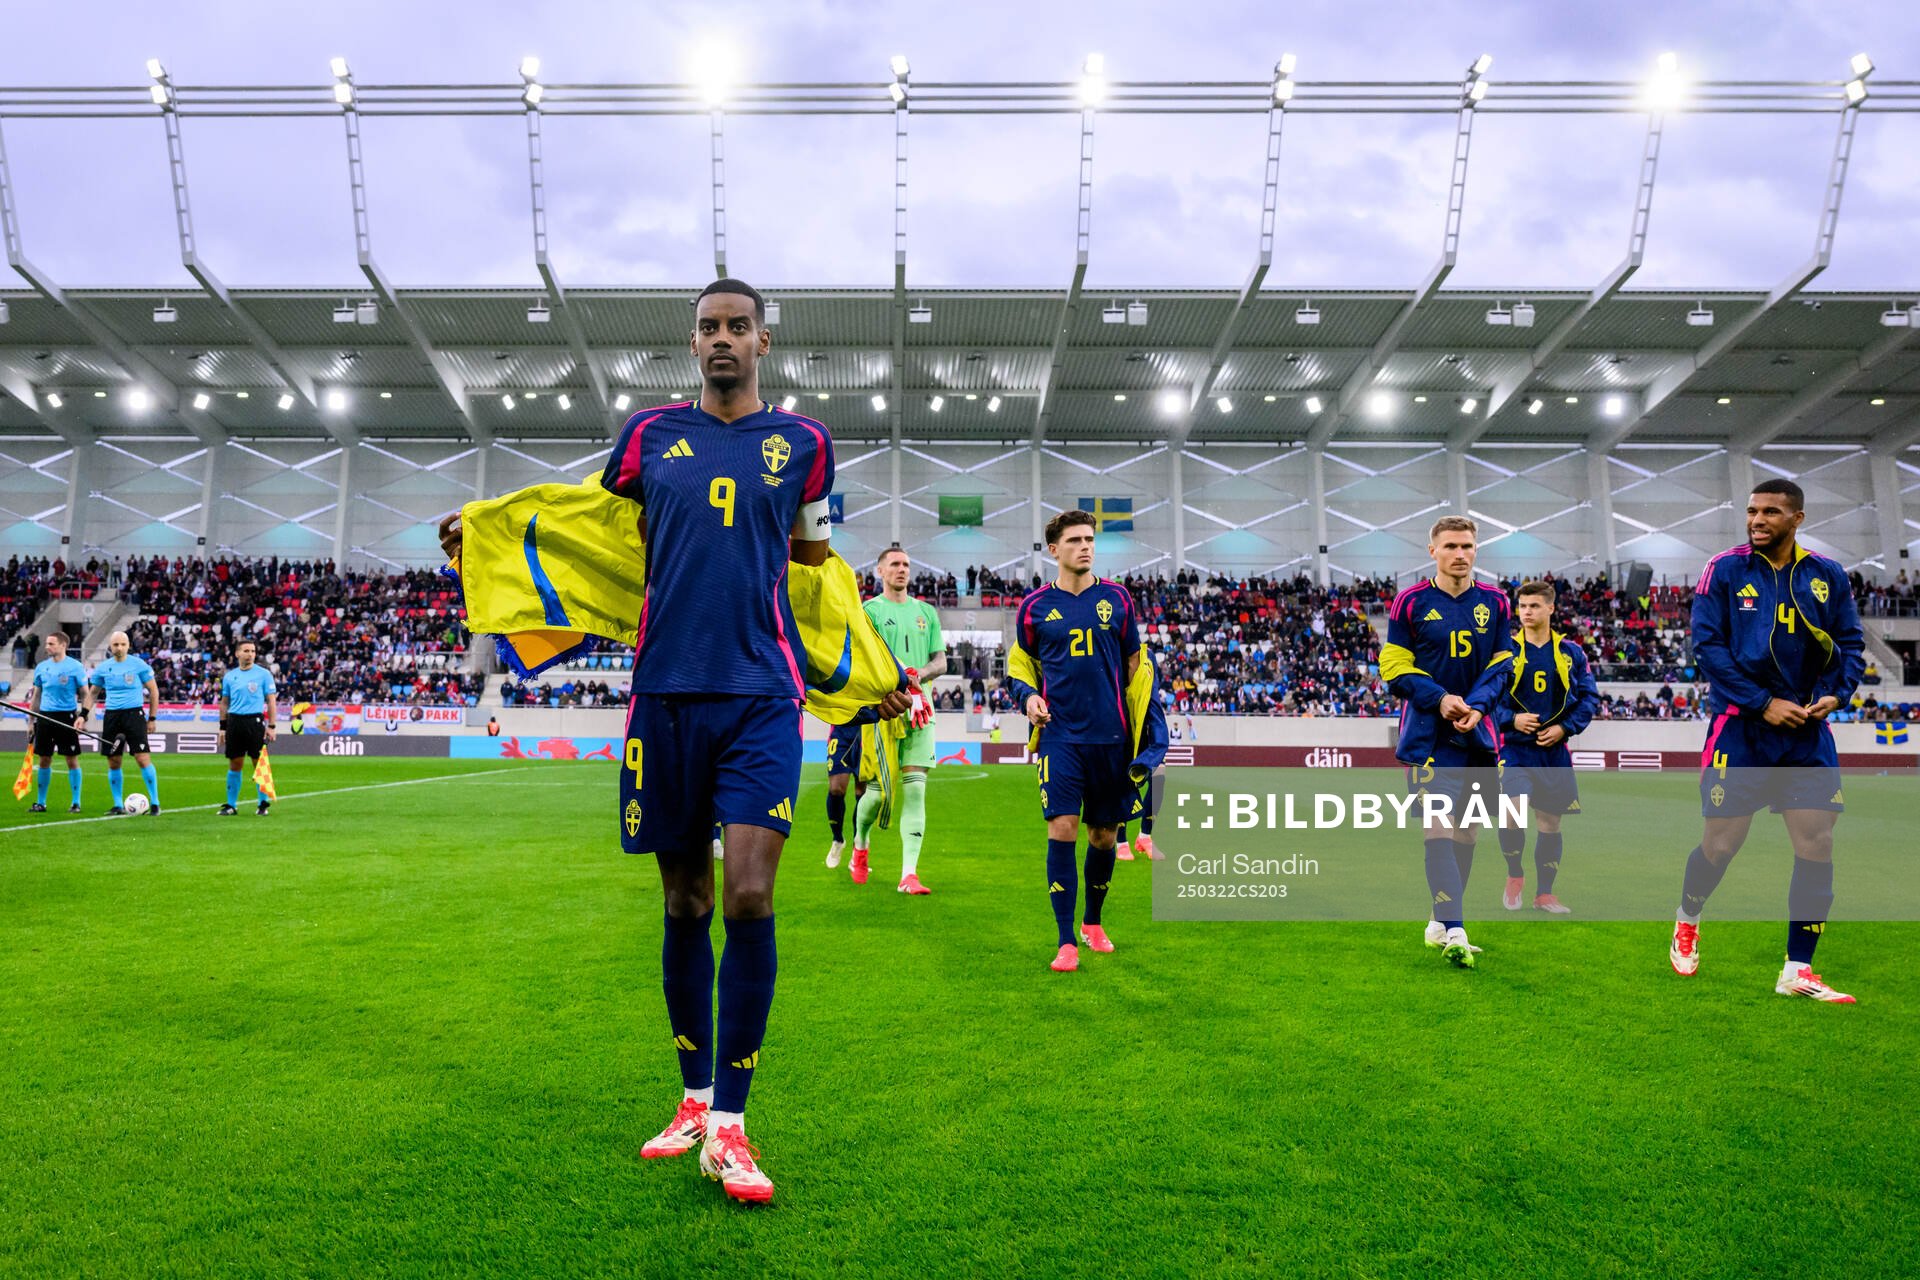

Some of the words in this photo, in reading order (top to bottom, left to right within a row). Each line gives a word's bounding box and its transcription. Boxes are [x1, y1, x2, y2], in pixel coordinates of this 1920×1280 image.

[709, 477, 736, 527] 9
[1778, 602, 1795, 634] 4
[905, 634, 909, 653] 1
[1069, 628, 1094, 657] 21
[1450, 630, 1472, 658] 15
[1534, 670, 1547, 693] 6
[425, 709, 459, 721] PARK
[320, 735, 364, 756] däin
[1305, 747, 1352, 768] däin
[626, 737, 643, 790] 9
[1713, 749, 1728, 779] 4
